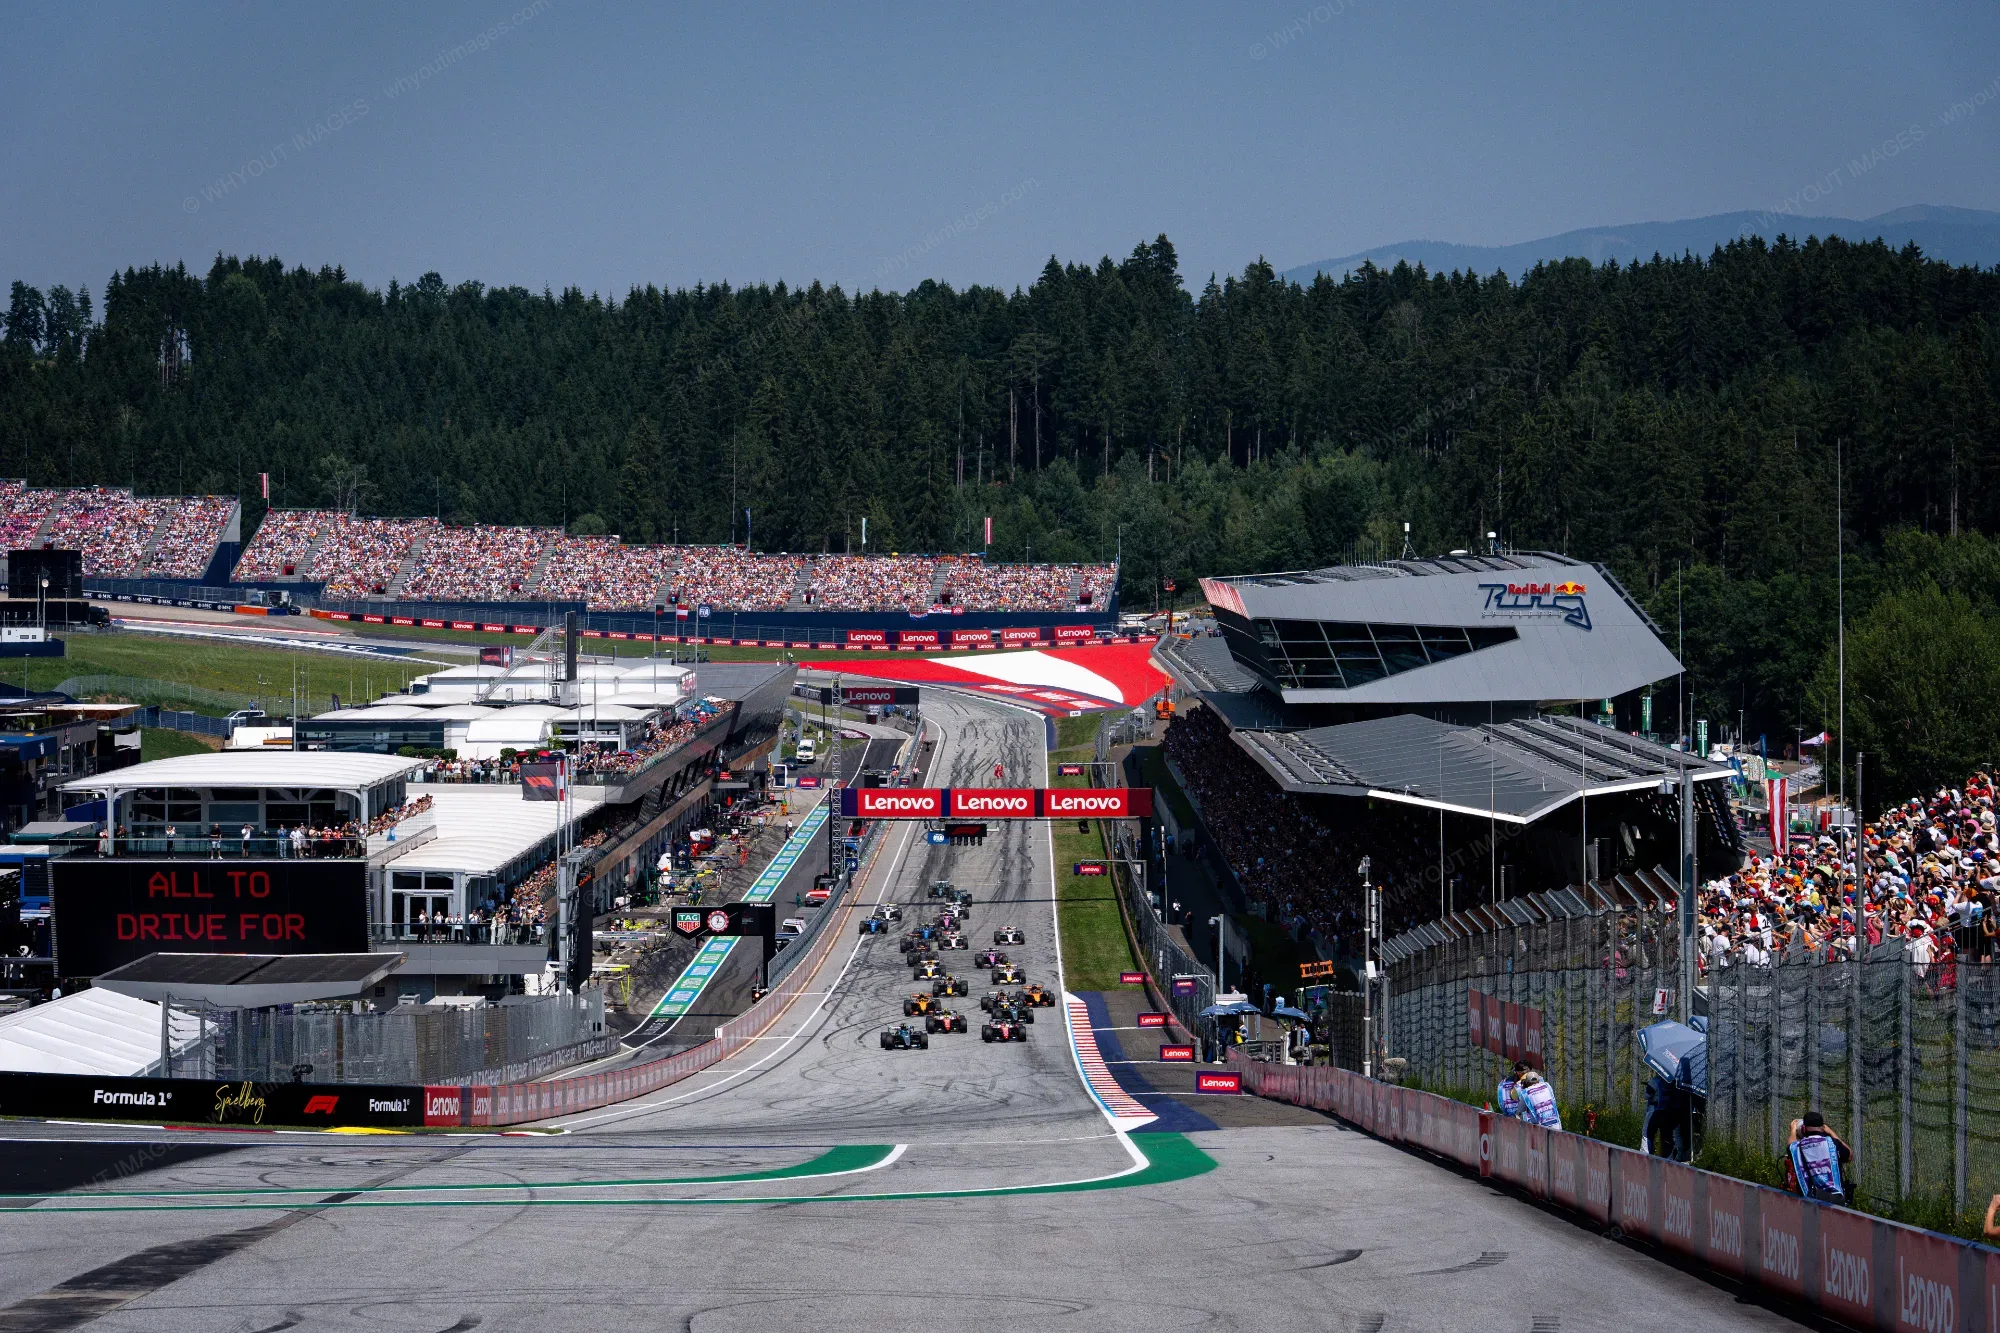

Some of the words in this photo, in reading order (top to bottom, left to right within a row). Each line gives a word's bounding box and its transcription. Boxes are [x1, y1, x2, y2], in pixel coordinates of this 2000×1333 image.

[1508, 583, 1529, 595] Red
[1530, 583, 1550, 595] Bull
[331, 612, 348, 620] Lenovo
[364, 615, 382, 623] Lenovo
[394, 618, 412, 626] Lenovo
[424, 620, 442, 628] Lenovo
[454, 622, 473, 630] Lenovo
[515, 626, 534, 634] Lenovo
[850, 632, 882, 641] Lenovo
[903, 634, 934, 642] Lenovo
[956, 633, 988, 641] Lenovo
[1004, 630, 1037, 639] Lenovo
[1058, 629, 1090, 637] Lenovo
[849, 691, 890, 700] Lenovo
[865, 794, 934, 810] Lenovo
[957, 794, 1028, 810] Lenovo
[1051, 794, 1121, 810] Lenovo
[149, 872, 214, 898] ALL
[227, 872, 270, 898] TO
[117, 914, 227, 940] DRIVE
[240, 914, 305, 940] FOR
[678, 922, 699, 933] HEUER
[1203, 1079, 1235, 1087] Lenovo
[94, 1089, 156, 1106] Formula
[214, 1081, 266, 1124] Spielberg
[427, 1093, 459, 1116] Lenovo
[303, 1096, 340, 1114] F1
[369, 1098, 402, 1112] Formula
[1622, 1170, 1648, 1222] Lenovo
[1664, 1182, 1692, 1239] Lenovo
[1710, 1196, 1741, 1258] Lenovo
[1762, 1212, 1799, 1281] Lenovo
[1824, 1232, 1869, 1308] Lenovo
[1900, 1256, 1954, 1333] Lenovo
